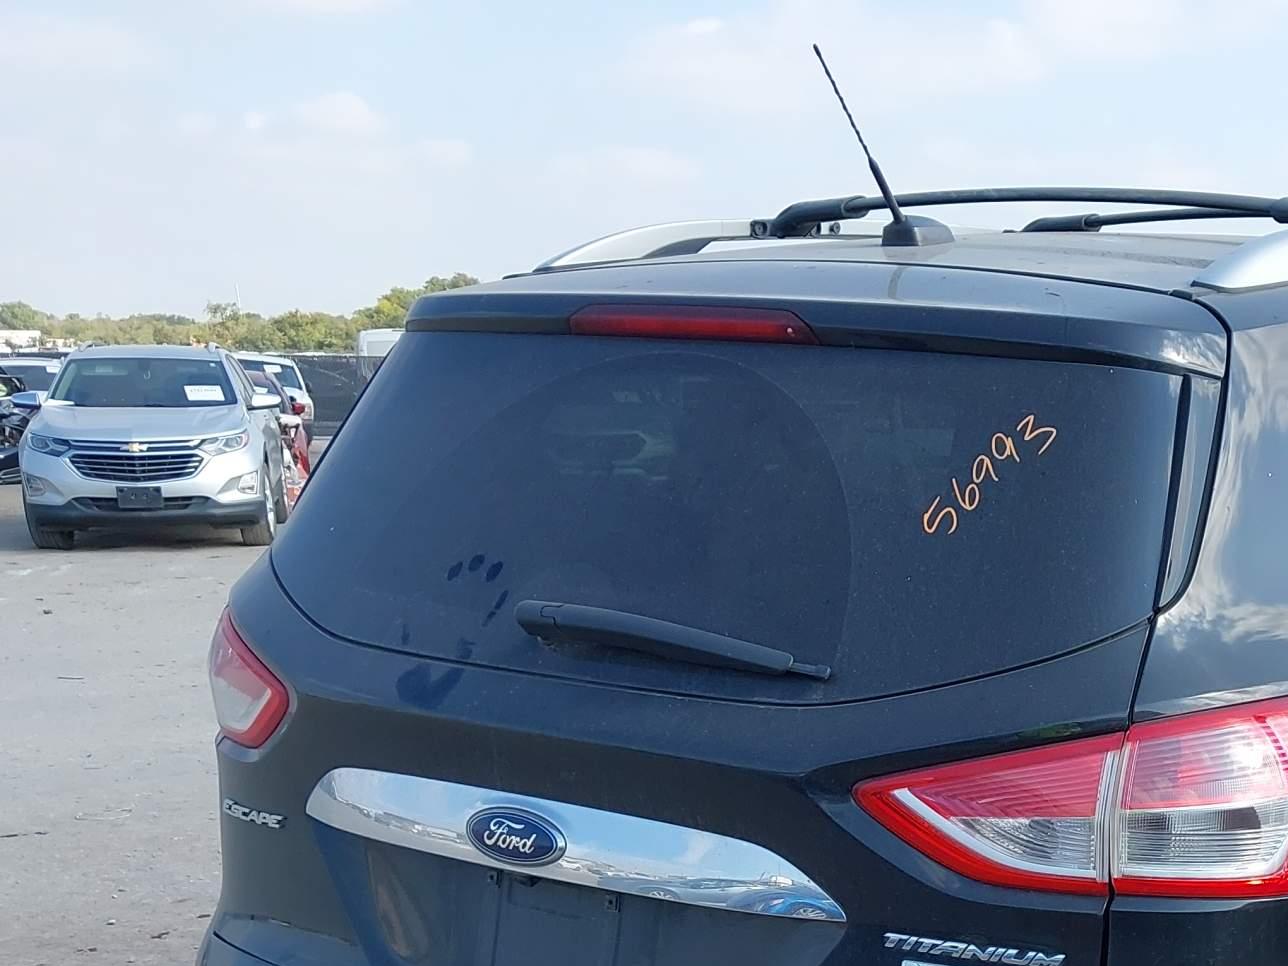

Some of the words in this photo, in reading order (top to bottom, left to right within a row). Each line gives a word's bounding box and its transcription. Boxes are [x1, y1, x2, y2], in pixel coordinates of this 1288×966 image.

[922, 414, 1057, 535] 56993
[223, 798, 285, 829] ESCAPE
[483, 817, 537, 854] Ford
